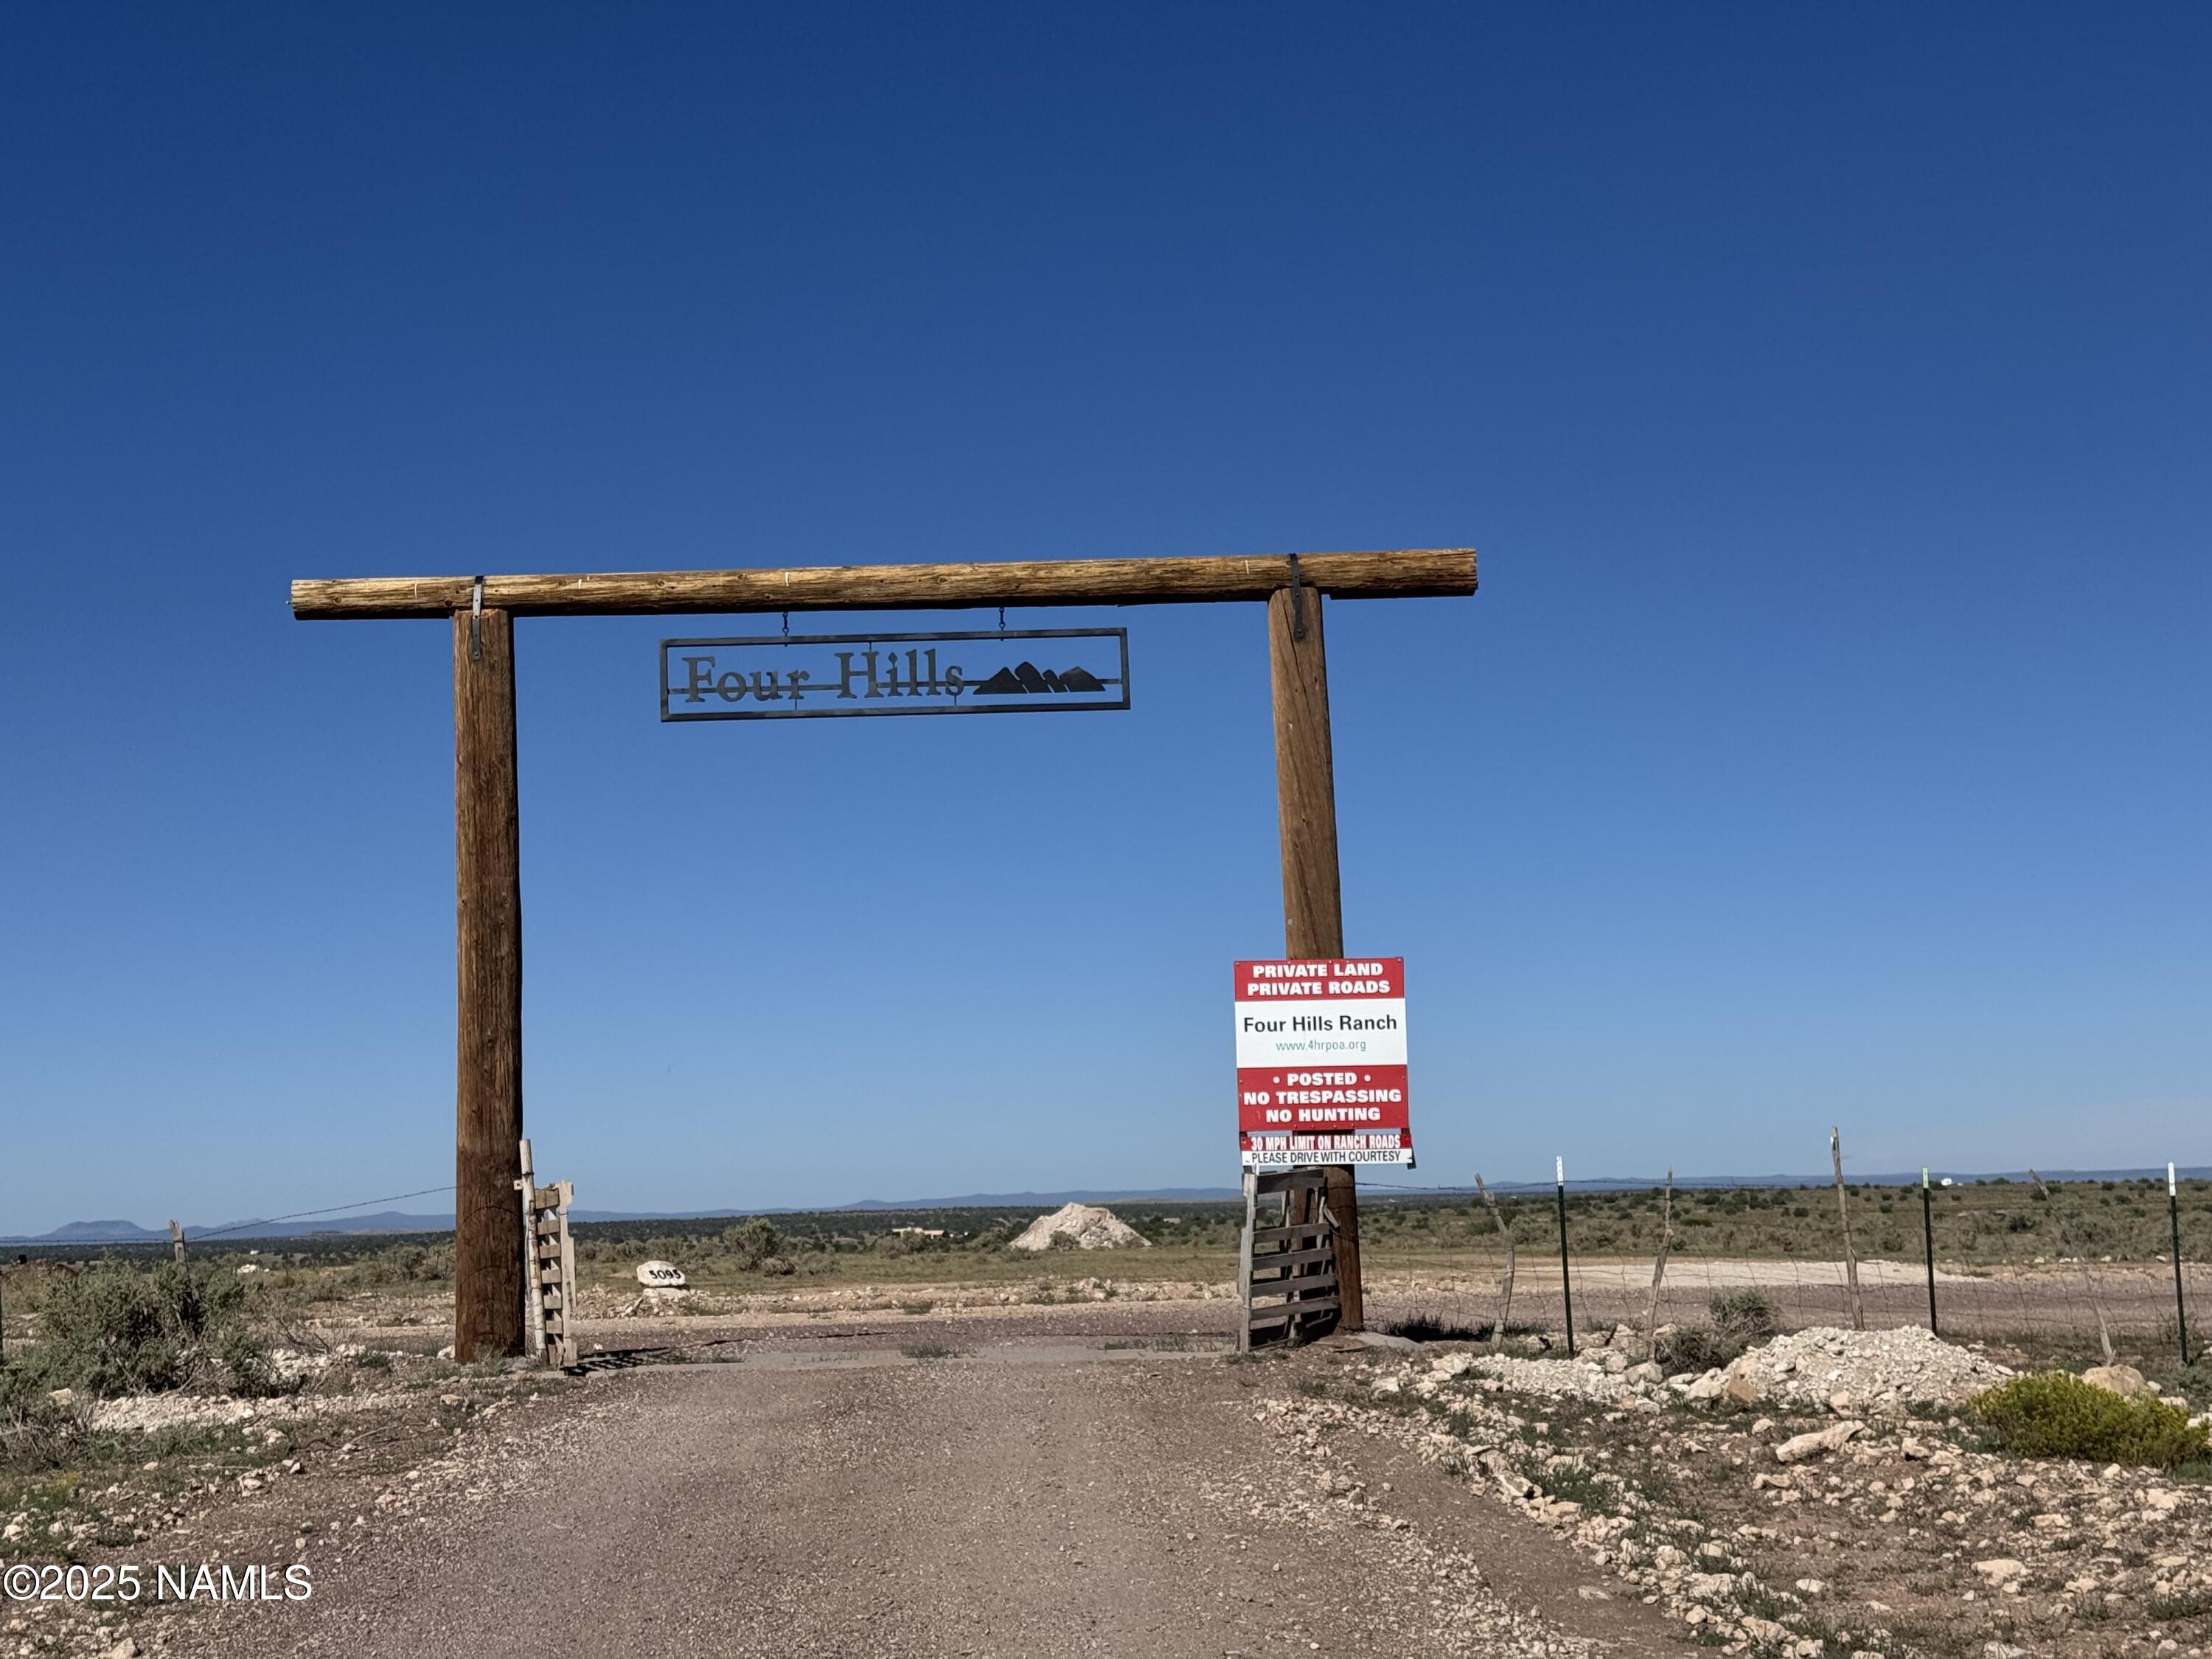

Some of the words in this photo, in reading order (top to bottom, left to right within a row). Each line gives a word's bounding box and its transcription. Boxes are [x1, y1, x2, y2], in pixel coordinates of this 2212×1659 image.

[681, 655, 810, 703] Four
[835, 648, 964, 700] Hills
[1253, 964, 1328, 978] PRIVATE
[1334, 963, 1383, 977] LAND
[1248, 982, 1322, 996] PRIVATE
[1329, 981, 1391, 995] ROADS
[1244, 1017, 1286, 1032] Four
[1293, 1015, 1333, 1032] Hills
[1340, 1015, 1397, 1031] Ranch
[1276, 1040, 1366, 1052] www.4hrpoa.org
[1287, 1072, 1357, 1086] POSTED
[1243, 1092, 1270, 1105] NO
[1276, 1089, 1402, 1105] TRESPASSING
[1266, 1109, 1293, 1123] NO
[1298, 1107, 1381, 1122] HUNTING
[1251, 1137, 1263, 1151] 30
[1265, 1136, 1287, 1151] MPH
[1290, 1135, 1315, 1150] LIMIT
[1318, 1135, 1331, 1150] ON
[1334, 1135, 1367, 1150] RANCH
[1369, 1134, 1401, 1150] ROADS
[1252, 1152, 1287, 1164] PLEASE
[1290, 1152, 1320, 1163] DRIVE
[1321, 1151, 1348, 1162] WITH
[1349, 1150, 1401, 1162] COURTESY
